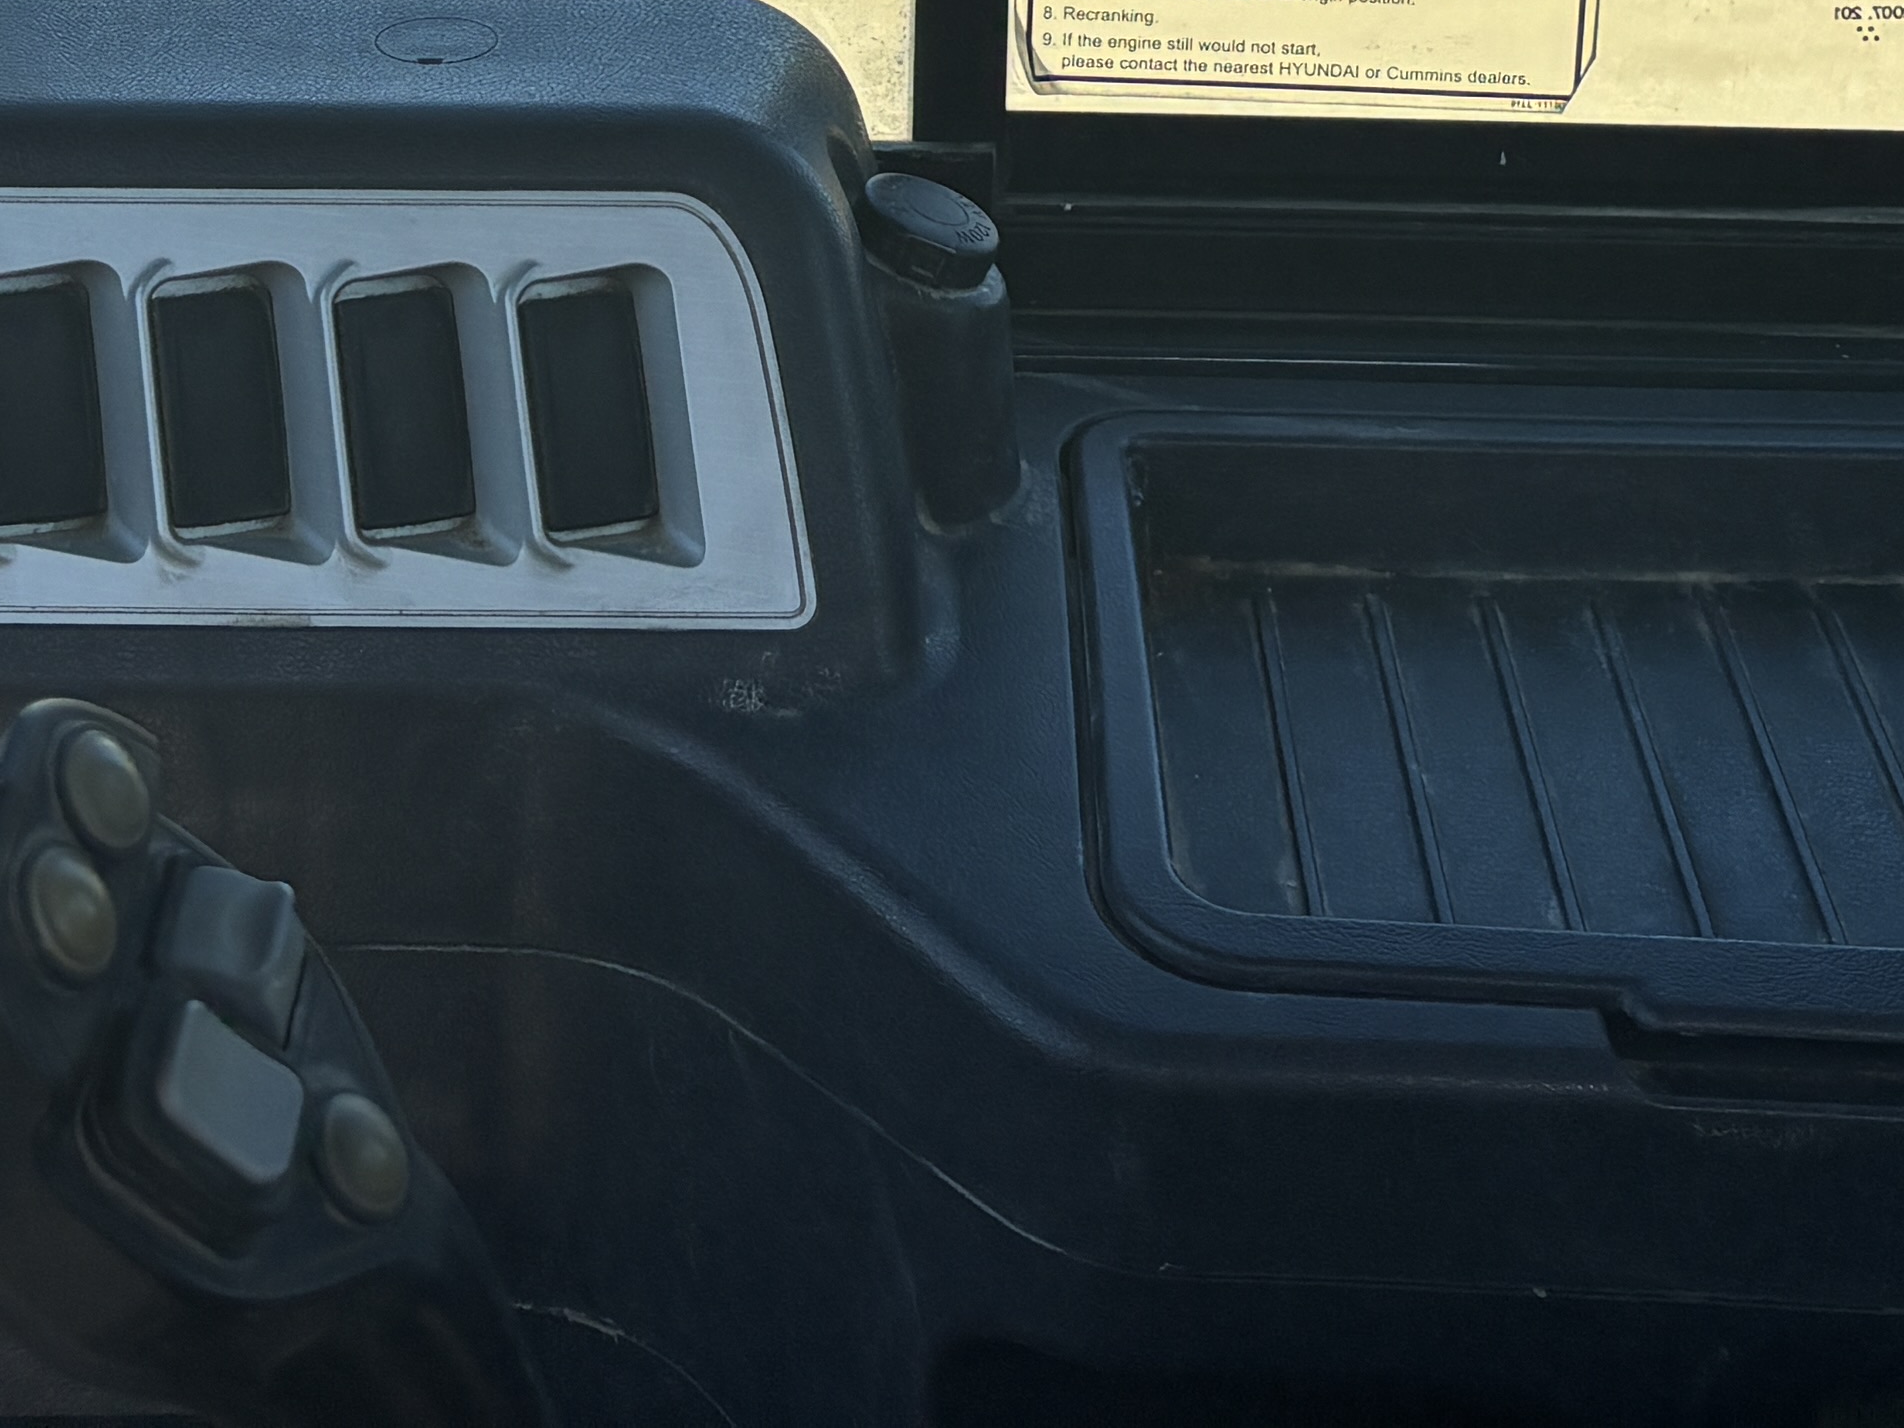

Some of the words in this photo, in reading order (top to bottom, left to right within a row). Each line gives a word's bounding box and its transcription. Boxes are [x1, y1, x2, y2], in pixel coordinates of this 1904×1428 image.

[1063, 5, 1159, 27] Recranking.
[1077, 33, 1103, 48] the
[1107, 37, 1162, 53] engine
[1167, 37, 1193, 51] still
[1198, 39, 1246, 53] would
[1251, 41, 1276, 55] not
[1281, 43, 1321, 57] start,
[1061, 54, 1114, 70] please
[1119, 57, 1178, 72] contact
[1183, 58, 1208, 73] the
[1213, 61, 1274, 76] nearest
[1279, 61, 1359, 79] HYUNDAI
[1386, 65, 1462, 83] Cummins
[1467, 70, 1531, 86] dealers.
